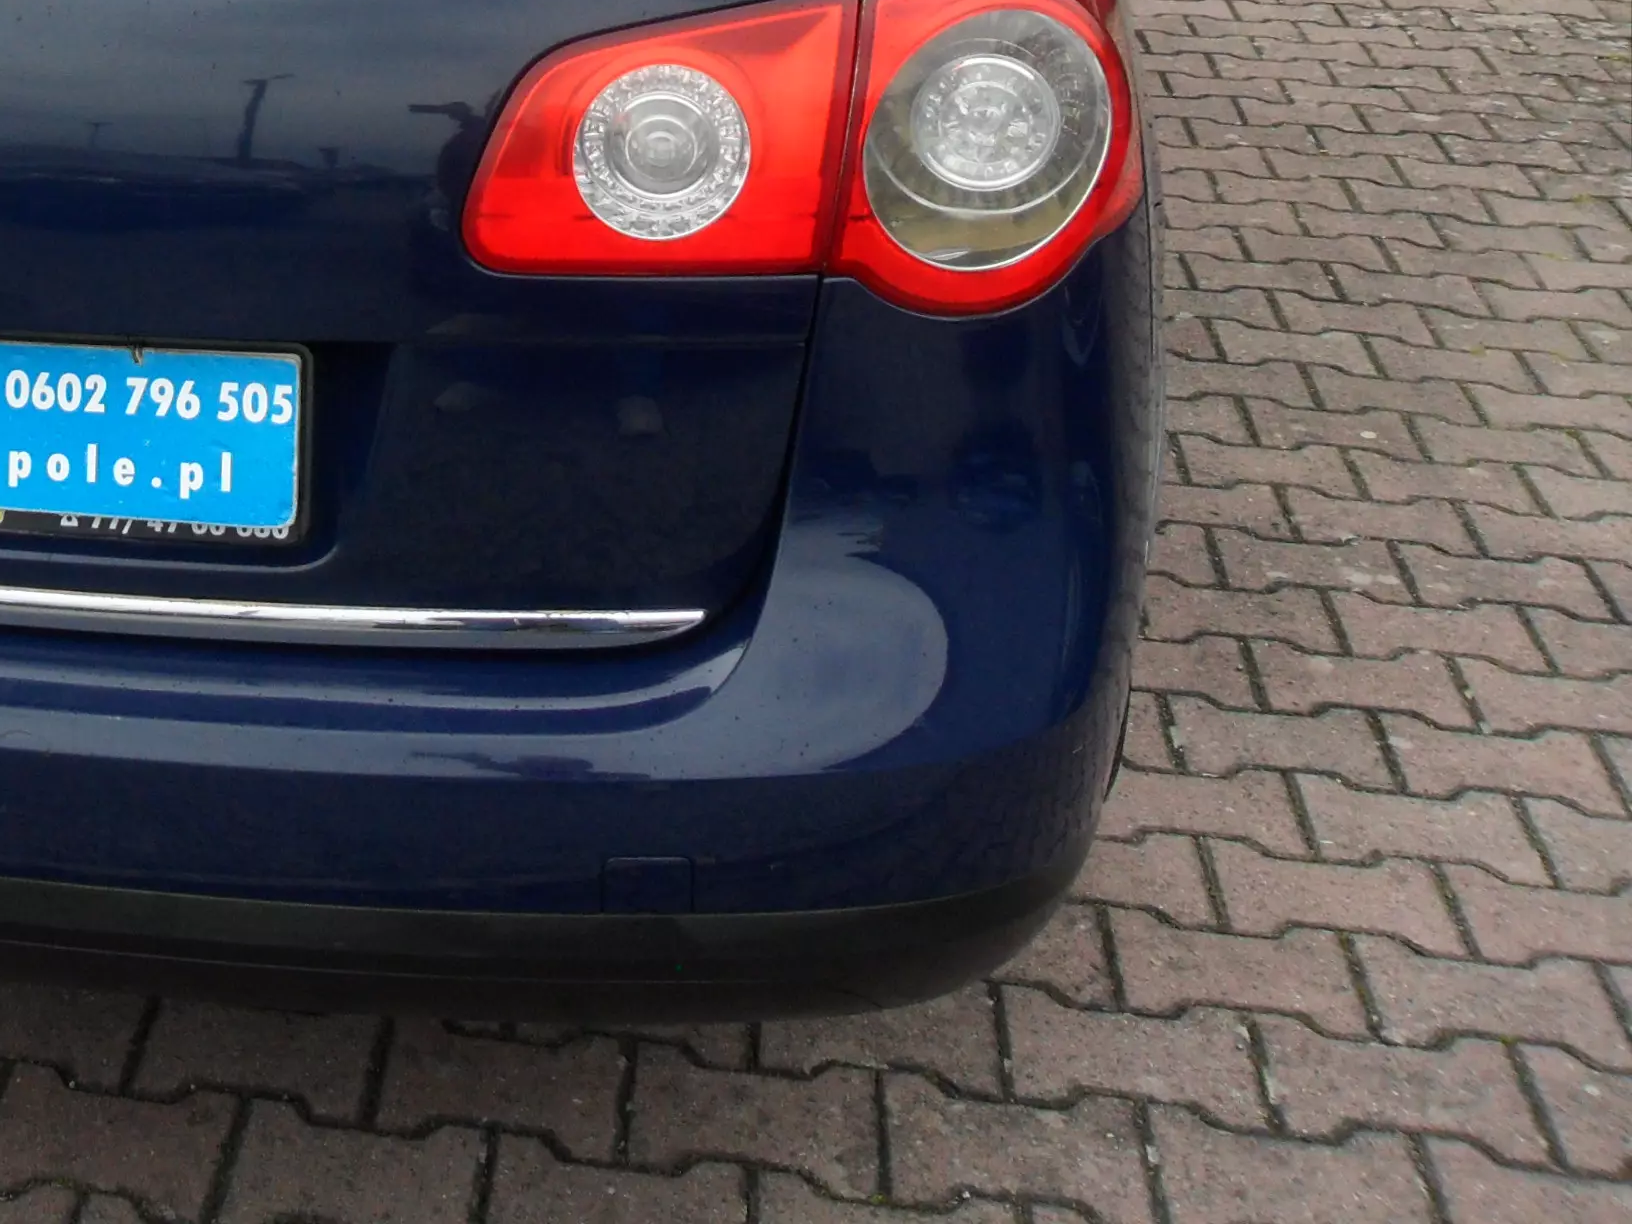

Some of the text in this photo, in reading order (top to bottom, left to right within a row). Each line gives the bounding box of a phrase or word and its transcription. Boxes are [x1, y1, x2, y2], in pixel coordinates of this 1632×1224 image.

[5, 369, 107, 414] 0602
[125, 377, 201, 419] 796
[217, 382, 293, 424] 505
